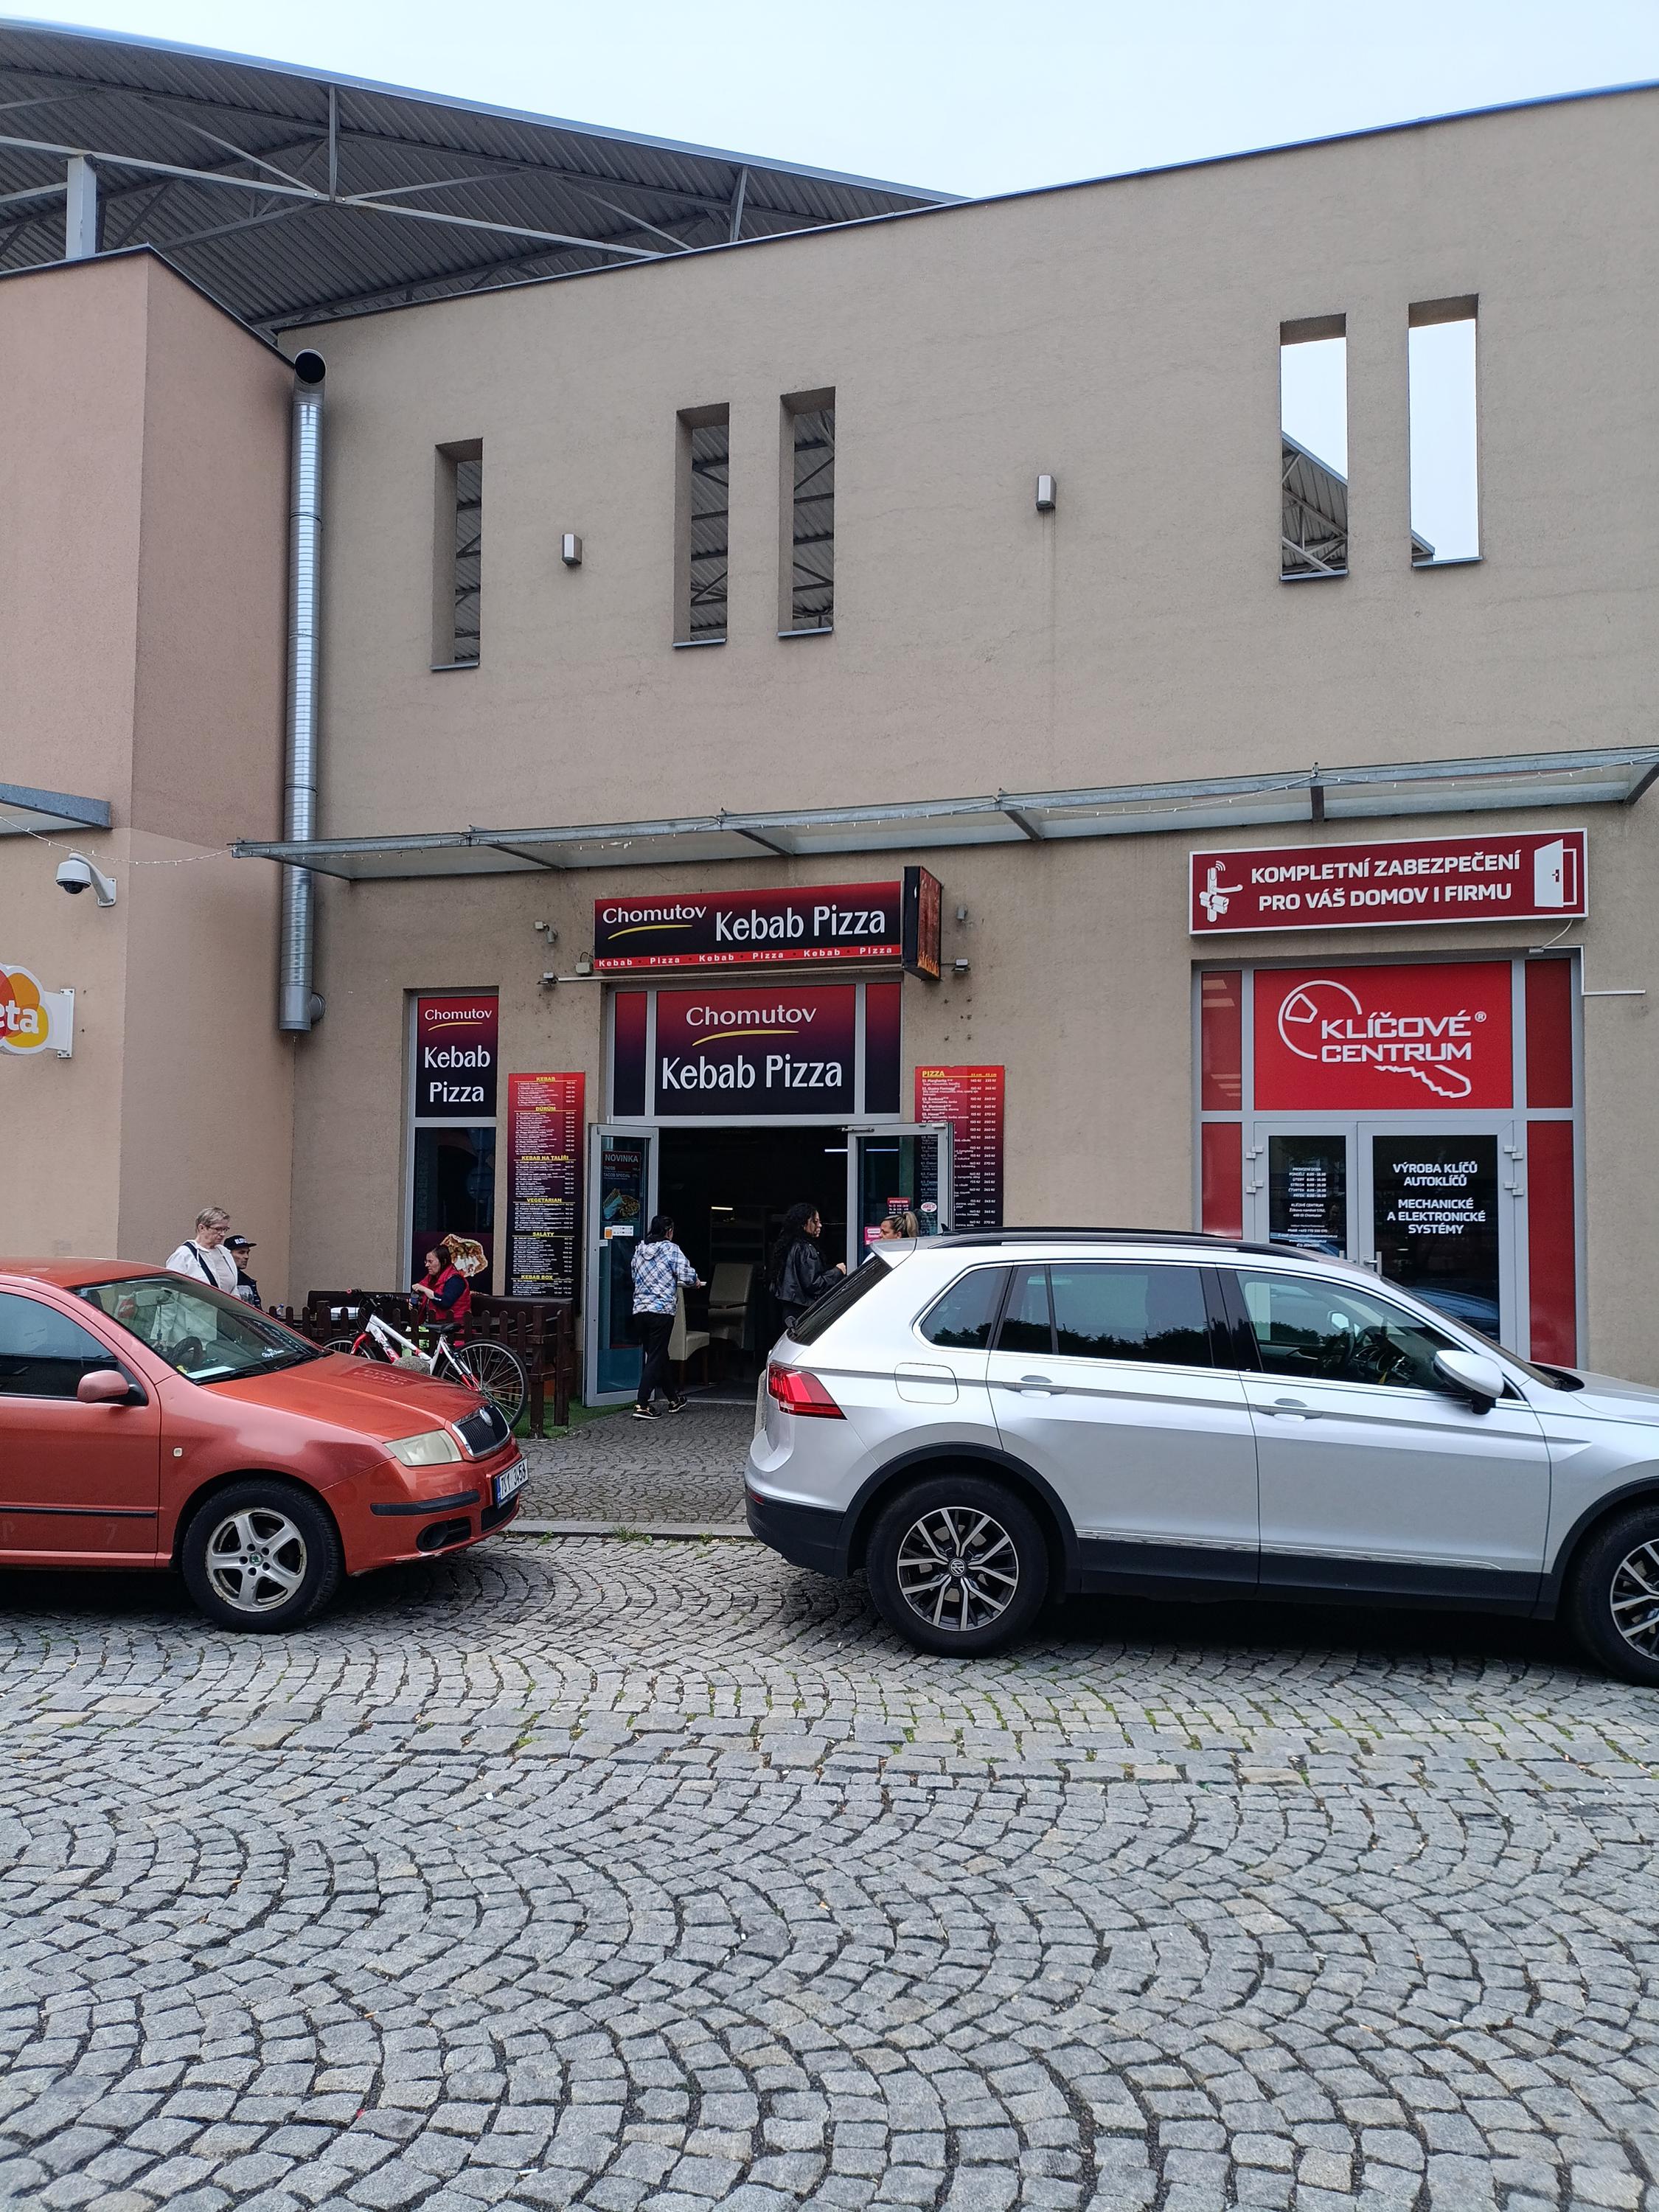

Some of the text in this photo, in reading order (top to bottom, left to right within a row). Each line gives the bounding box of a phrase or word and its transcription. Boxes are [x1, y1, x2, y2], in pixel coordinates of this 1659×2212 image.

[1251, 849, 1522, 883] KOMPLETNÍ ZABEZPEČENÍ
[1259, 882, 1512, 911] PRO VÁŠ DOMOV I FIRMU
[602, 904, 707, 924] Chomutov
[716, 904, 886, 942] Kebab Pizza
[599, 947, 892, 967] Kebab Pizza Kebab Pizza Kebab Pizza
[0, 1000, 40, 1034] ta
[425, 1008, 492, 1020] Chomutov
[686, 1004, 817, 1026] Chomutov
[1321, 1009, 1472, 1040] KLÍČOVÉ
[425, 1045, 490, 1069] Kebab
[1321, 1043, 1472, 1062] CENTRUM
[662, 1053, 842, 1090] Kebab Pizza
[429, 1081, 484, 1102] Pizza
[605, 1154, 639, 1163] NOVINKA
[1392, 1161, 1478, 1173] VÝROBA KLÍČŮ
[1403, 1174, 1467, 1186] AUTOKLÍČŮ
[1398, 1197, 1474, 1208] MECHANICKÉ
[1386, 1210, 1486, 1222] A ELEKTRONICKÉ
[1408, 1222, 1464, 1234] SYSTÉMY
